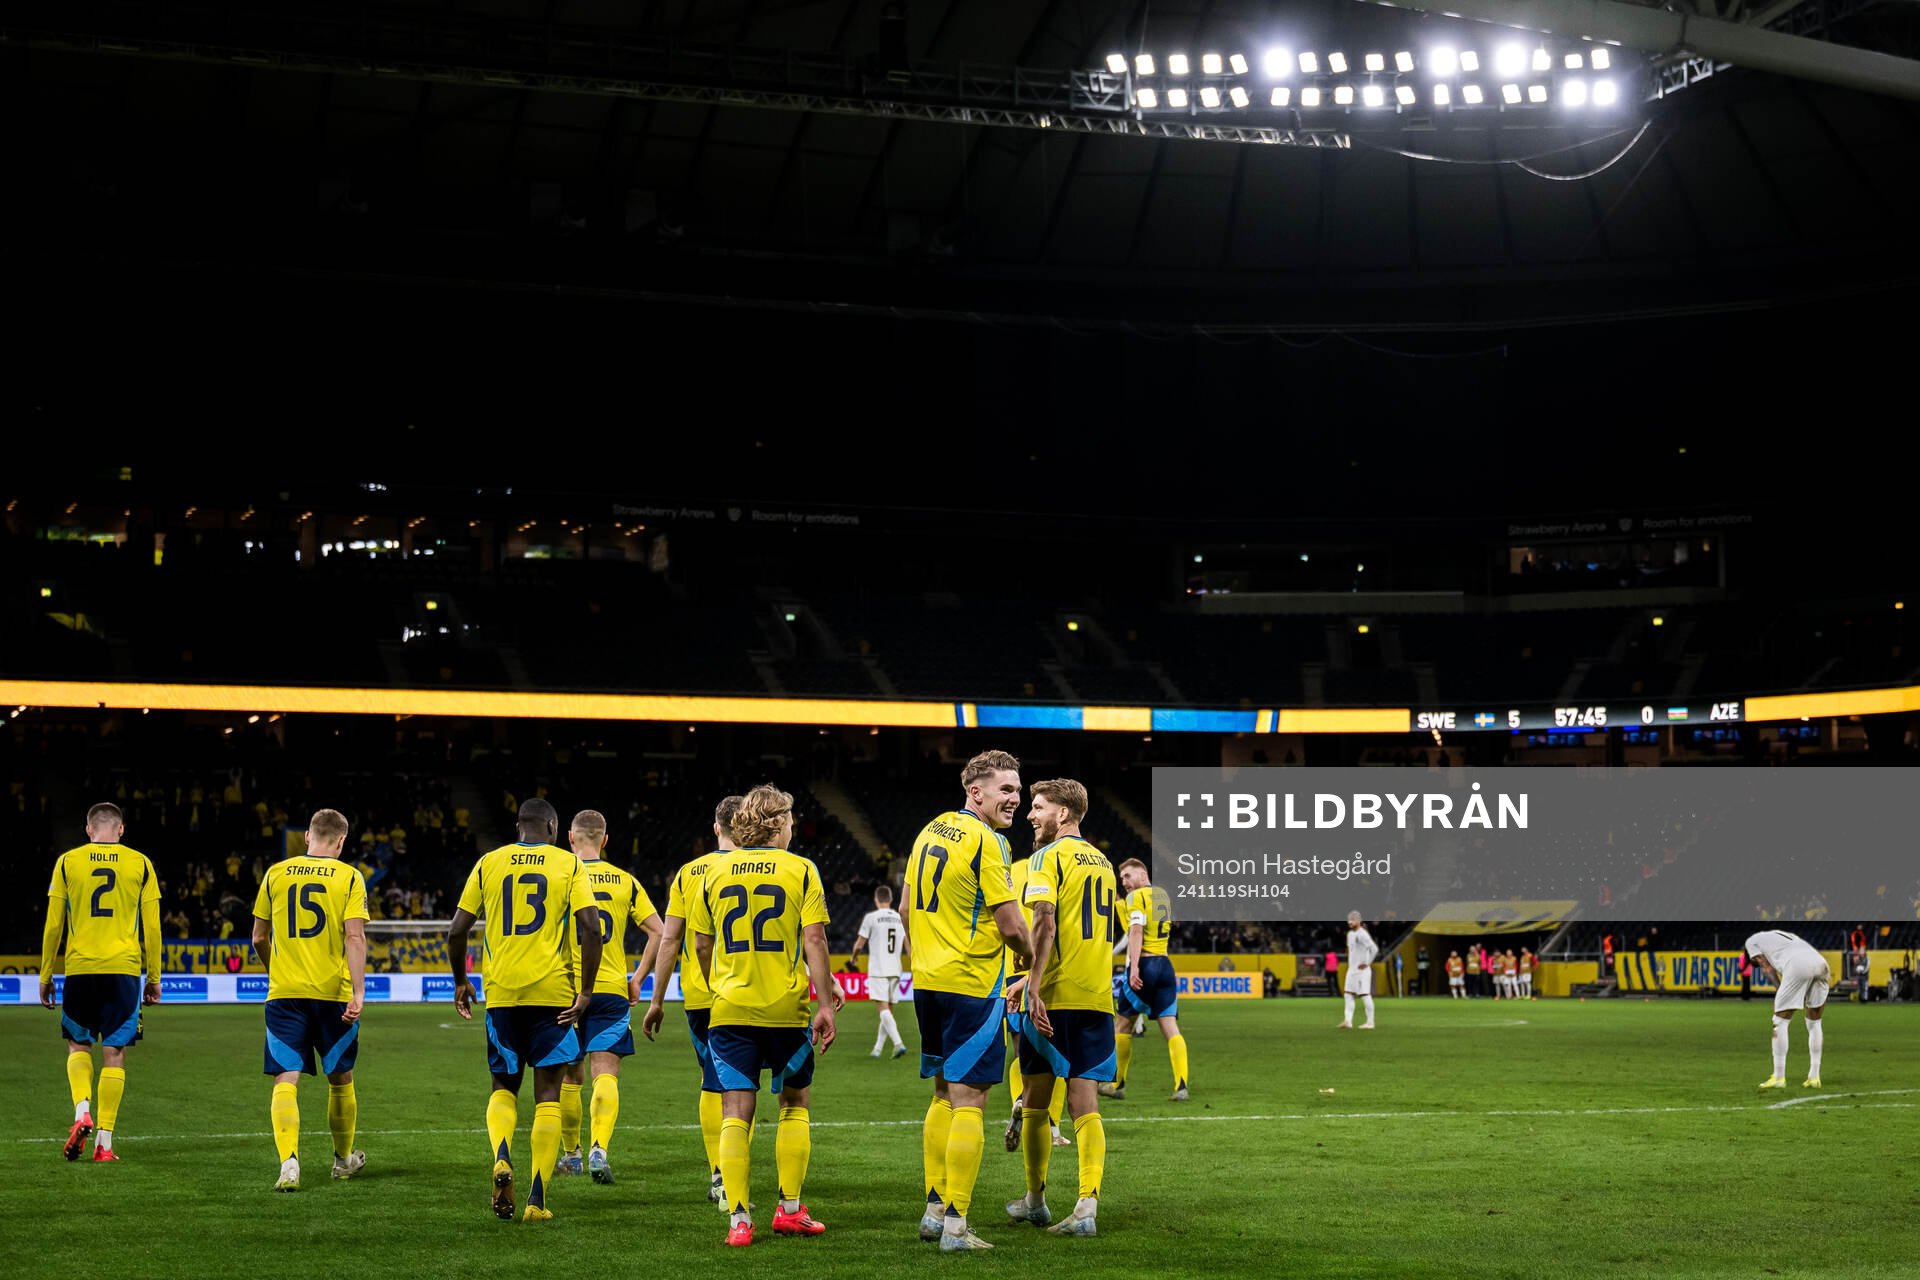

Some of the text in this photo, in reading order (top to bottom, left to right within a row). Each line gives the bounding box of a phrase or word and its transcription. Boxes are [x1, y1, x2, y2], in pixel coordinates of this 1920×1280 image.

[612, 503, 716, 520] Strawberry Arena
[752, 509, 861, 525] Room for emotions
[1507, 521, 1608, 537] Strawberry Arena
[1642, 516, 1677, 529] Room
[1679, 515, 1695, 528] for
[1417, 702, 1739, 729] SWE 5 57:45 0 AZE
[90, 853, 118, 862] HOLM
[511, 854, 545, 865] SEMA
[286, 866, 336, 878] STARFELT
[732, 862, 776, 875] NANASI
[588, 871, 621, 884] STRÖM
[915, 842, 949, 913] 17
[91, 868, 116, 917] 2
[287, 882, 327, 938] 15
[502, 873, 548, 936] 13
[1082, 875, 1113, 942] 14
[719, 883, 786, 954] 22
[888, 928, 896, 954] 5
[1673, 957, 1686, 985] VI
[1690, 956, 1710, 985] ÄR
[160, 980, 192, 990] exel
[1192, 976, 1252, 993] SVERIGE
